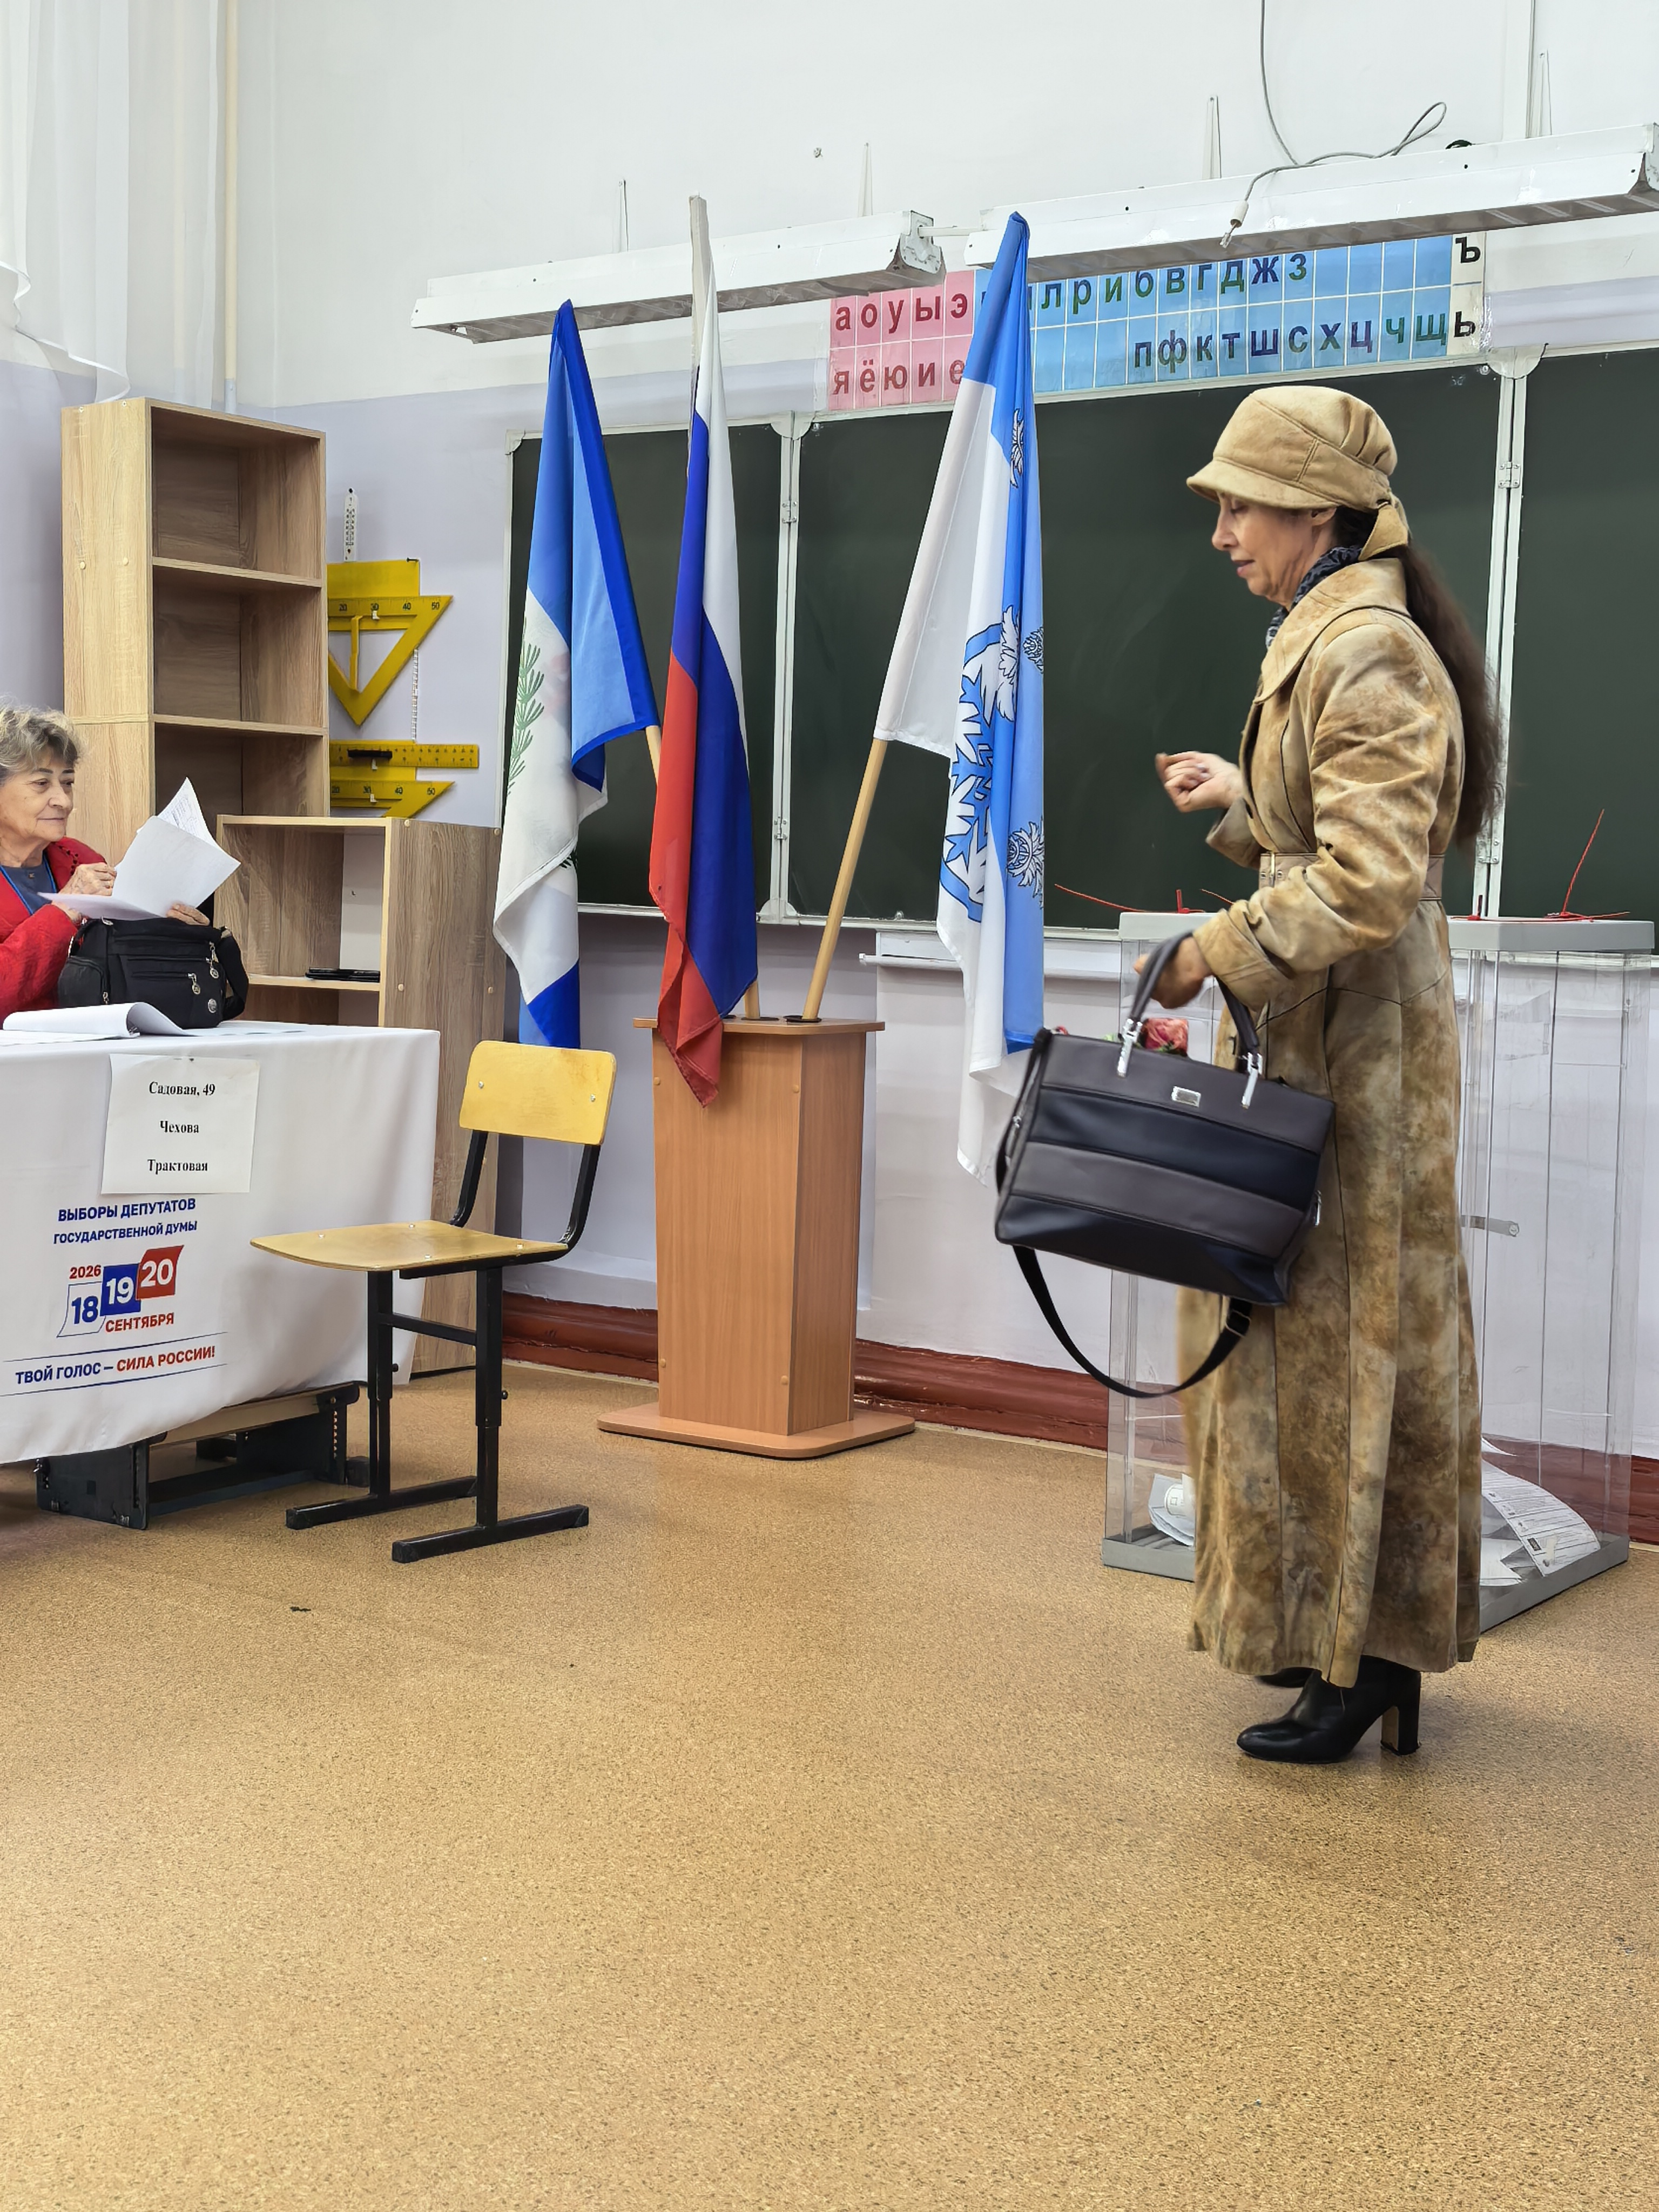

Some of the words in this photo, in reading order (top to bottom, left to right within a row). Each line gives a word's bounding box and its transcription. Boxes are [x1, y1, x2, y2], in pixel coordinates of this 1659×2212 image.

[403, 602, 412, 610] 40
[431, 602, 440, 610] 50
[394, 786, 403, 794] 40
[427, 787, 436, 795] 50
[149, 1081, 199, 1096] Садовая,
[203, 1084, 215, 1096] 49
[160, 1121, 199, 1133] Чехова
[147, 1159, 208, 1175] Трактовая
[58, 1205, 118, 1222] ВЫБОРЫ
[120, 1198, 196, 1219] ДЕПУТАТОВ
[53, 1223, 163, 1244] ГОСУДАРСТВЕННОЙ
[165, 1220, 198, 1236] ДУМЫ
[69, 1265, 102, 1279] 2026
[71, 1296, 98, 1324] 18
[106, 1277, 134, 1305] 19
[140, 1258, 174, 1287] 20
[105, 1312, 174, 1332] СЕНТЯБРЯ
[15, 1365, 53, 1384] ТВОЙ
[56, 1362, 102, 1380] ГОЛОС
[117, 1355, 155, 1372] СИЛА
[158, 1345, 215, 1367] РОССИИ!
